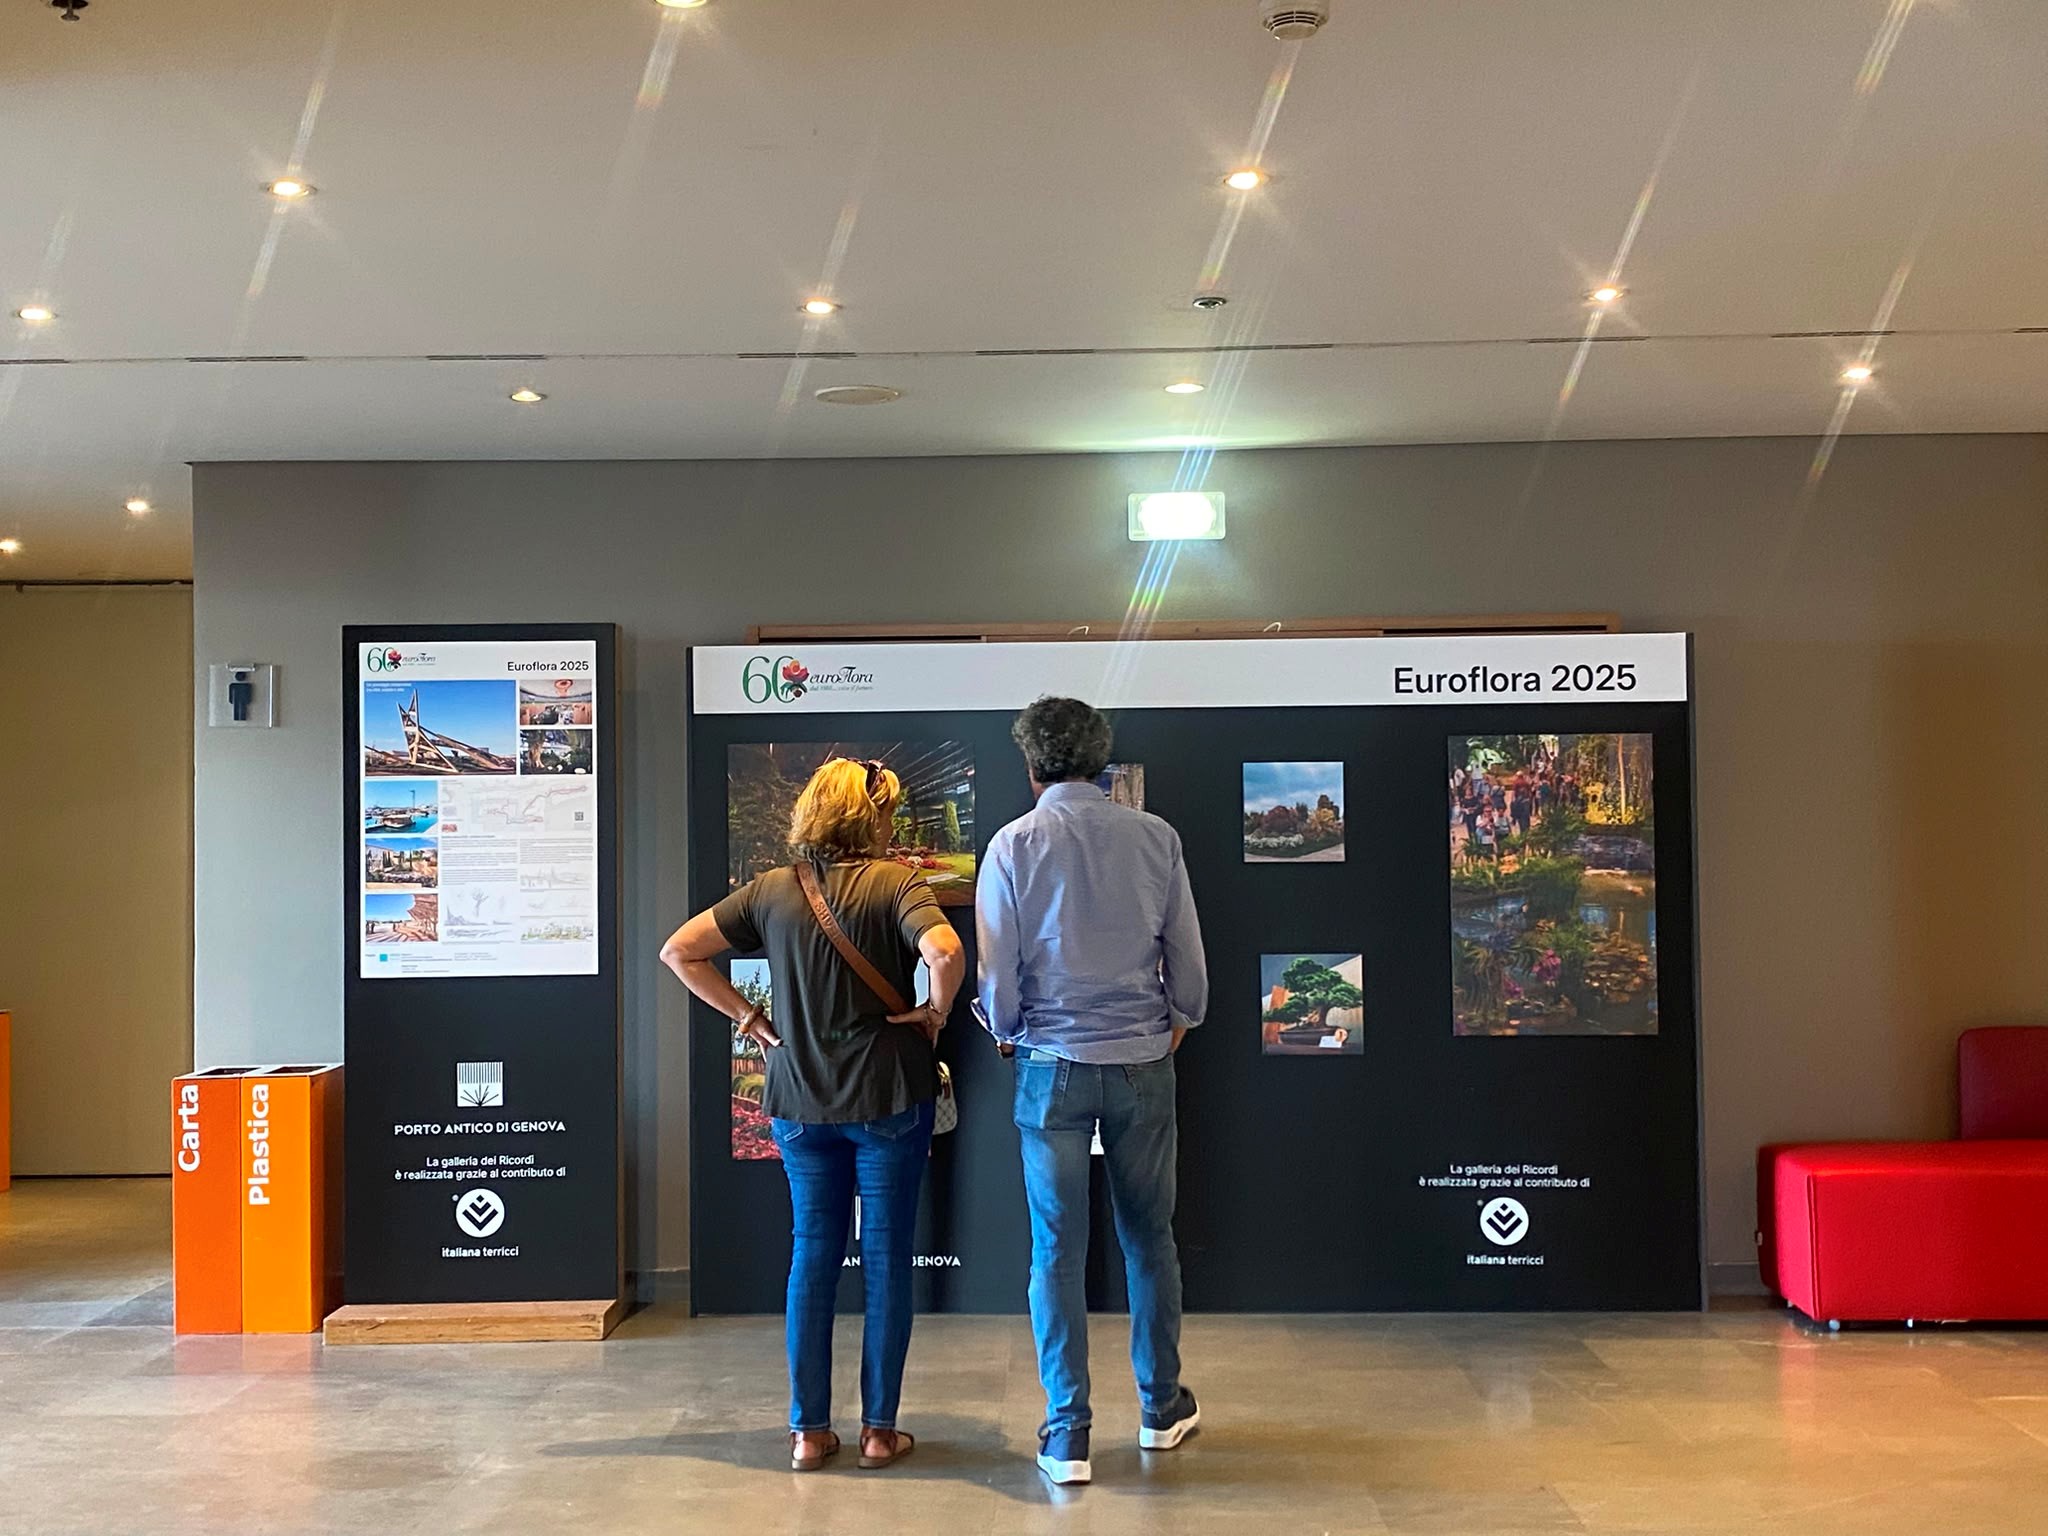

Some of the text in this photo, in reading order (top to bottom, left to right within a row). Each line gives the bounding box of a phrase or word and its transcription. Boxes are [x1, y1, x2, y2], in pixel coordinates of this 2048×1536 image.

[507, 660, 589, 671] Euroflora 2025
[1394, 664, 1637, 693] Euroflora 2025
[178, 1084, 201, 1172] Carta
[394, 1121, 566, 1135] PORTO ANTICO DI GENOVA
[247, 1084, 270, 1205] Plastica
[426, 1154, 534, 1168] La galleria dei Ricordi
[404, 1169, 453, 1180] realizzata
[456, 1168, 487, 1181] grazie
[489, 1168, 499, 1178] al
[501, 1167, 553, 1178] contributo
[556, 1167, 566, 1177] di
[1450, 1165, 1558, 1176] La galleria dei Ricordi
[1419, 1176, 1590, 1189] è realizzata grazie al contributo di
[442, 1247, 519, 1257] italiana terricci
[1467, 1255, 1544, 1265] italiana terricci
